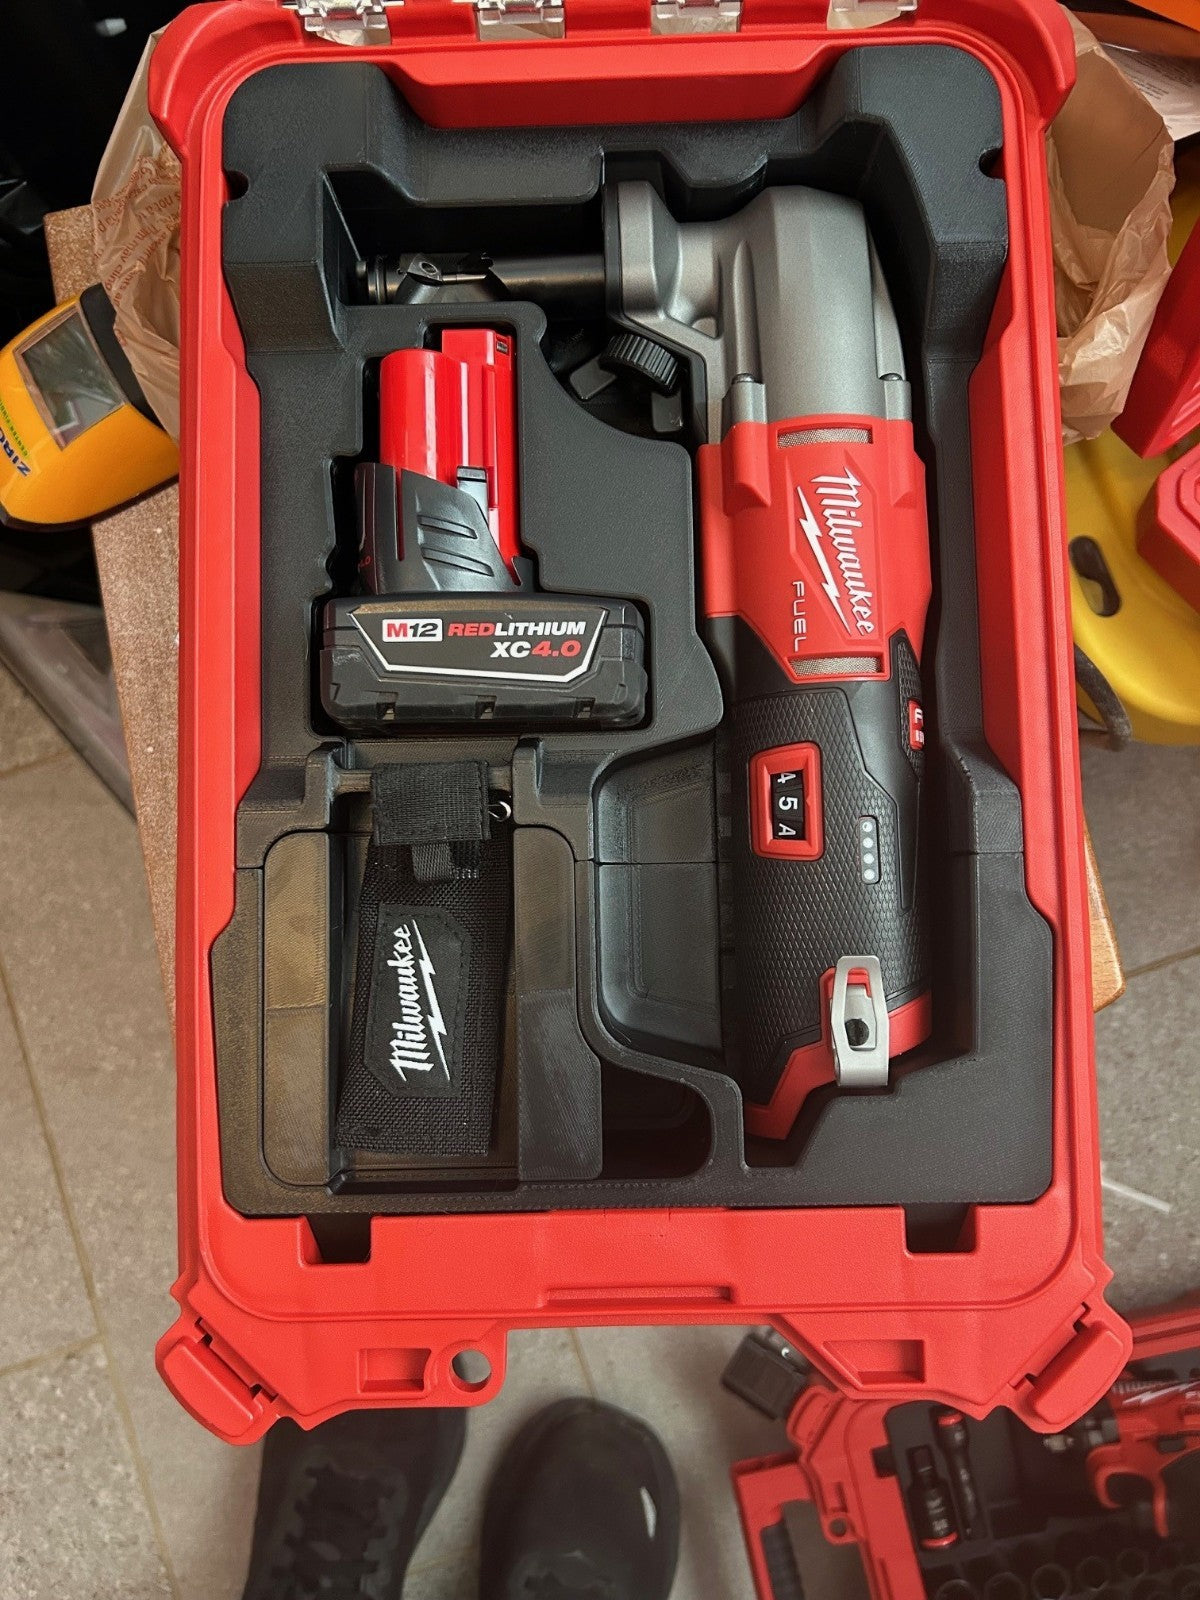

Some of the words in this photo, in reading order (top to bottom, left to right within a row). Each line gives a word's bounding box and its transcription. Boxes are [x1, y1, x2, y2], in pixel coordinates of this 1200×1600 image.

[809, 466, 875, 637] Milwaukee
[791, 580, 808, 653] FUEL
[386, 622, 439, 638] M12
[777, 772, 797, 784] 4
[778, 796, 799, 811] 5
[778, 822, 797, 837] A
[386, 923, 435, 1083] Milwaukee
